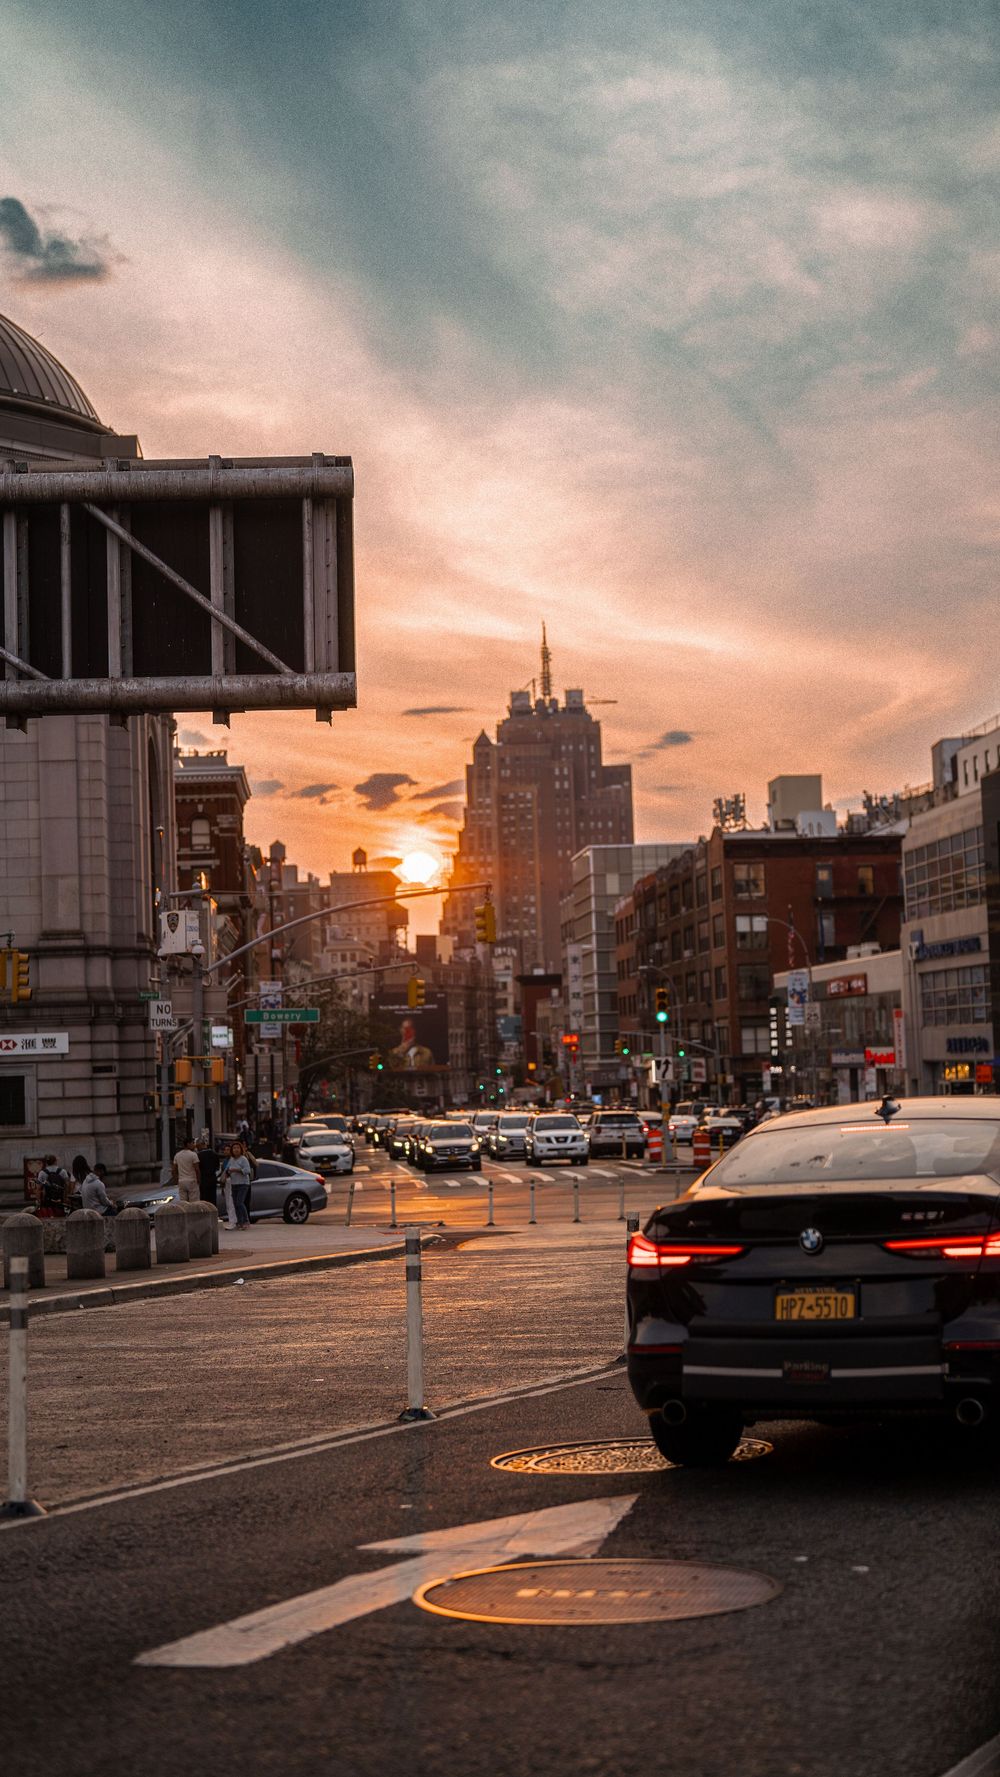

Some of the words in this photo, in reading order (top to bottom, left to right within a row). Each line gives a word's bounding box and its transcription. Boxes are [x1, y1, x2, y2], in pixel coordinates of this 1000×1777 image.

[156, 1004, 171, 1015] NO
[263, 1012, 301, 1021] Bowery
[151, 1018, 177, 1027] TURNS
